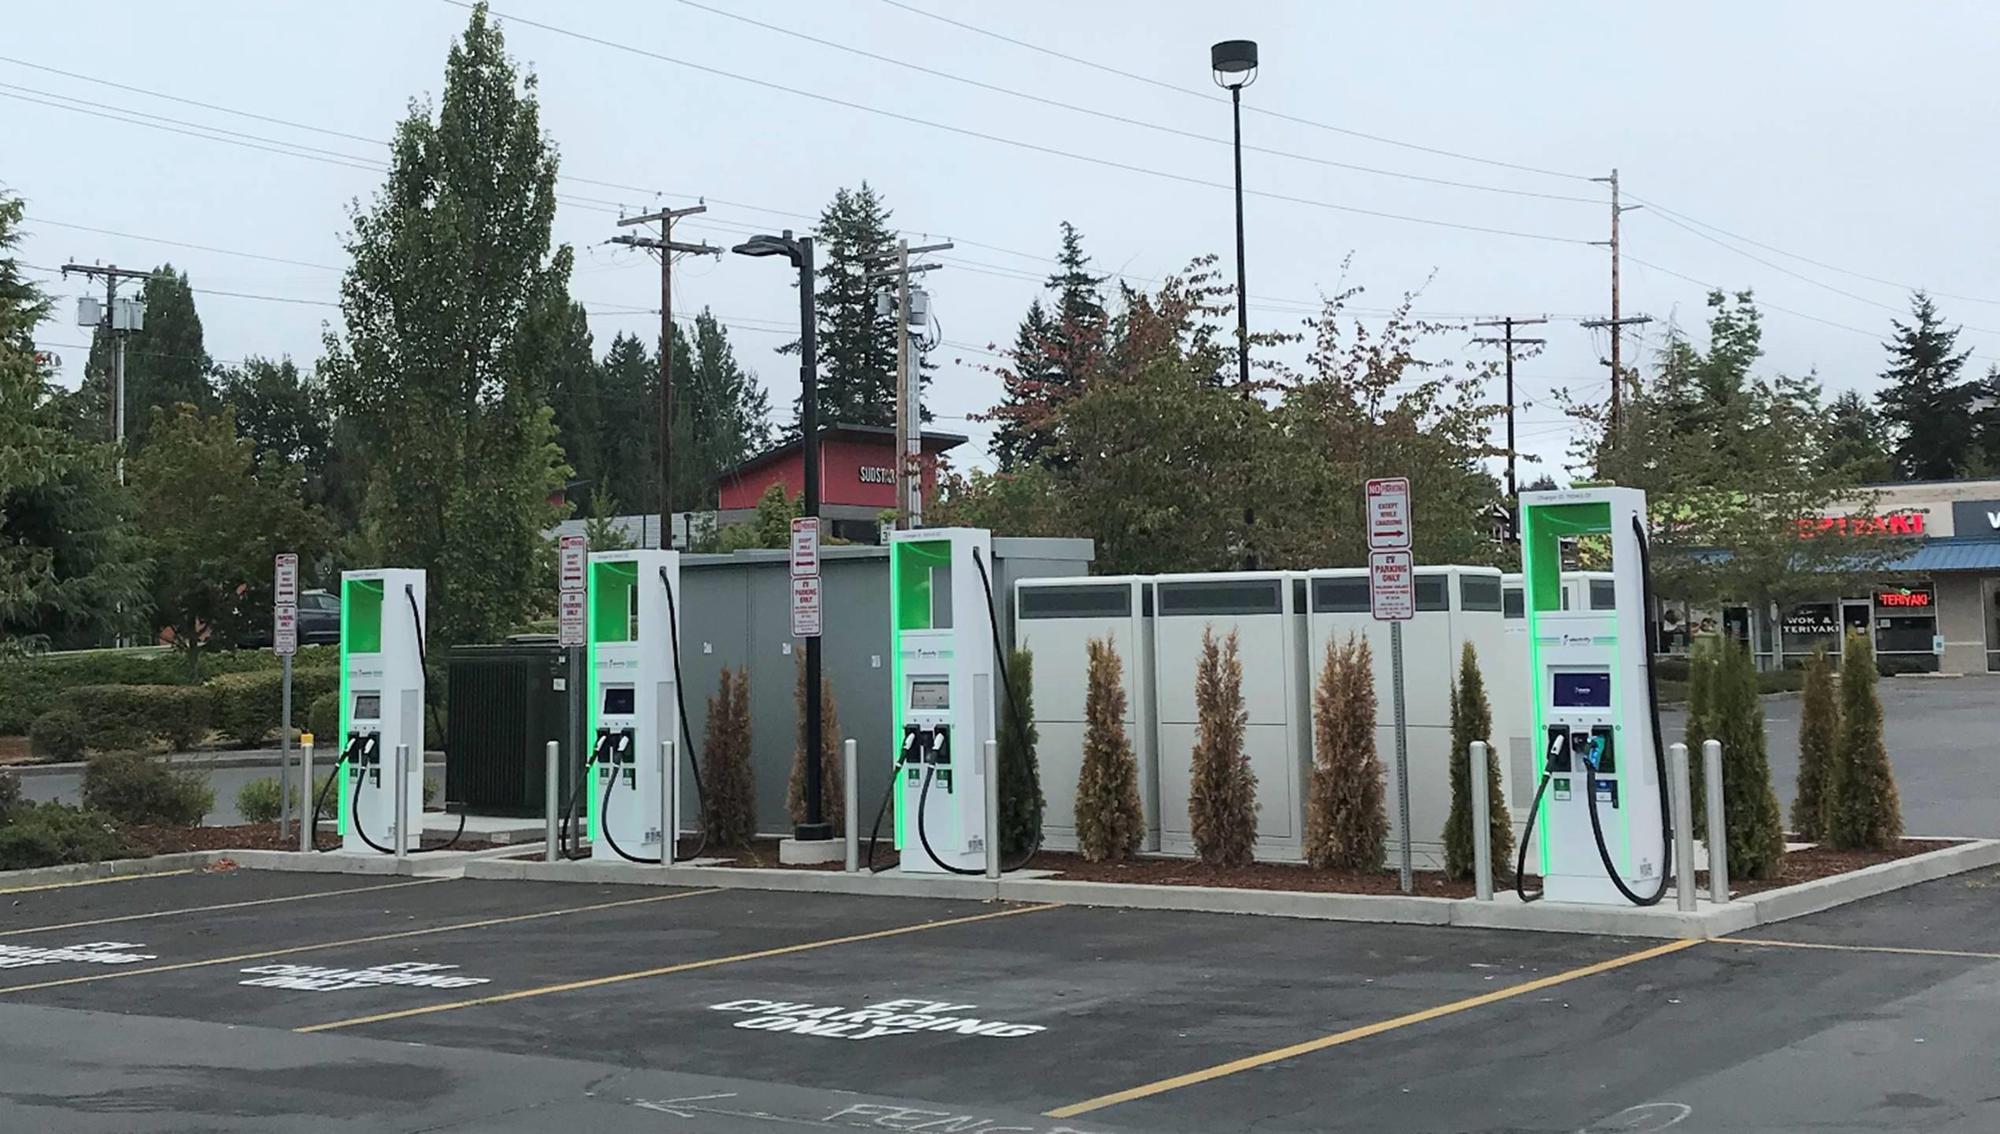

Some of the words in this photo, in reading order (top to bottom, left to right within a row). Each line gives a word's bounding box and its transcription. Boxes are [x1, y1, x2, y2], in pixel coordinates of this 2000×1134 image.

[1375, 565, 1408, 573] PARKING
[1382, 574, 1400, 582] ONLY
[1881, 593, 1928, 606] TERIYAKI
[1787, 617, 1816, 625] WOK
[1783, 626, 1840, 634] TERIYAKI
[864, 999, 978, 1014] EV
[708, 999, 1047, 1037] CHARGING
[733, 1016, 917, 1040] ONLY
